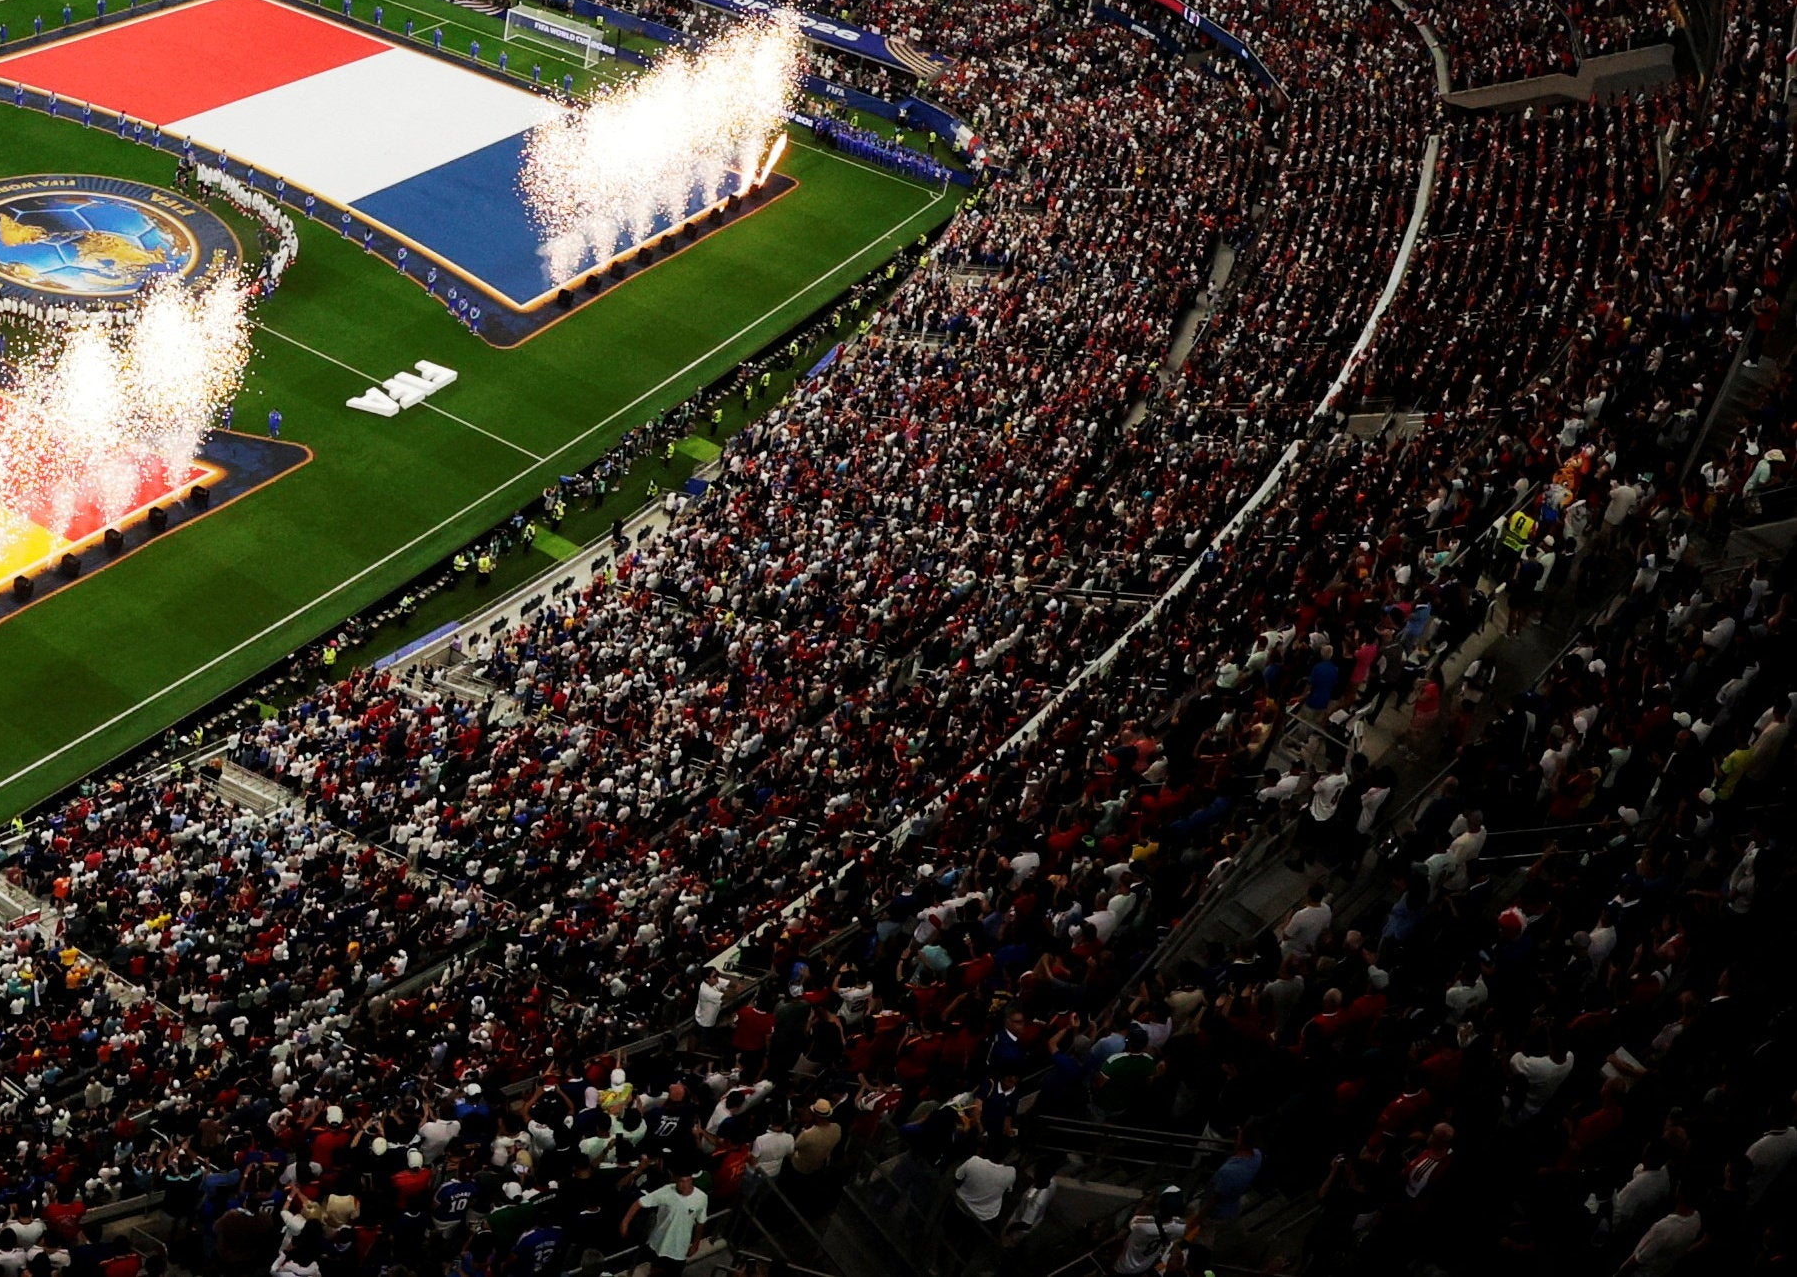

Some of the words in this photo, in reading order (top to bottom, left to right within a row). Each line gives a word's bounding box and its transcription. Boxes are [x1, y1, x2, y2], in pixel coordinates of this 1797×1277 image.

[534, 21, 550, 33] FIFA
[549, 26, 575, 41] WORLD
[826, 84, 845, 97] FIFA
[38, 179, 77, 188] FIFA
[150, 192, 196, 216] FIFA
[448, 1198, 469, 1213] 10
